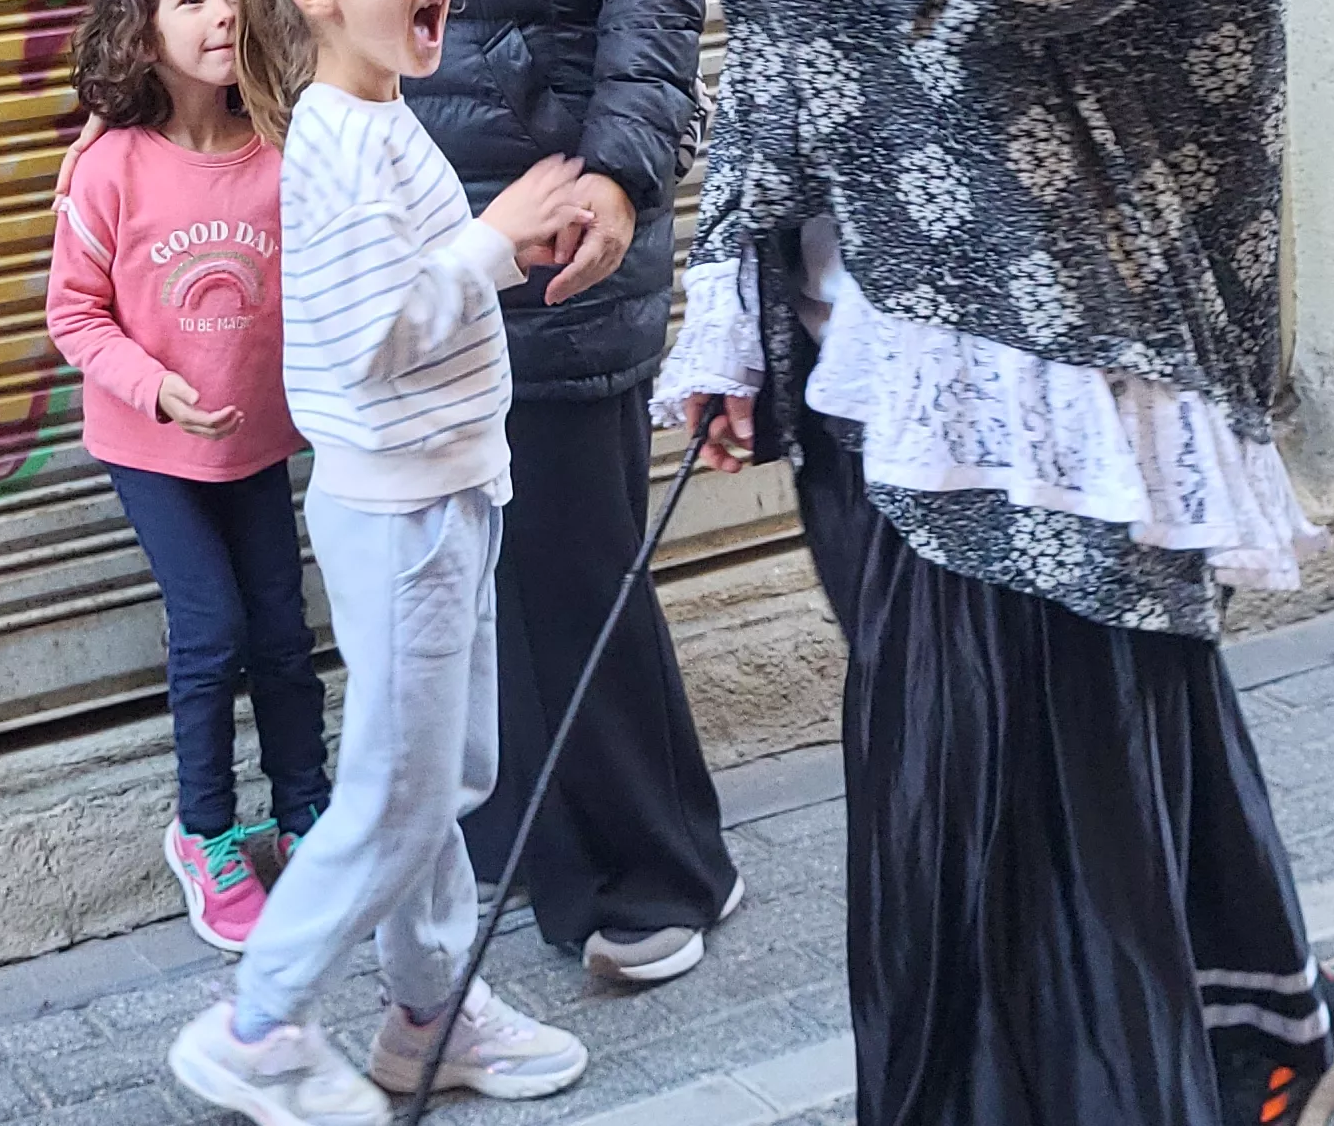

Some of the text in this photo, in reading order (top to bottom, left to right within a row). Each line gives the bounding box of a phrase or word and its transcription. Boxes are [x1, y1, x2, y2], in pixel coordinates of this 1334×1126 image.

[150, 219, 229, 265] GOOD
[178, 317, 194, 332] TO
[197, 317, 215, 333] BE
